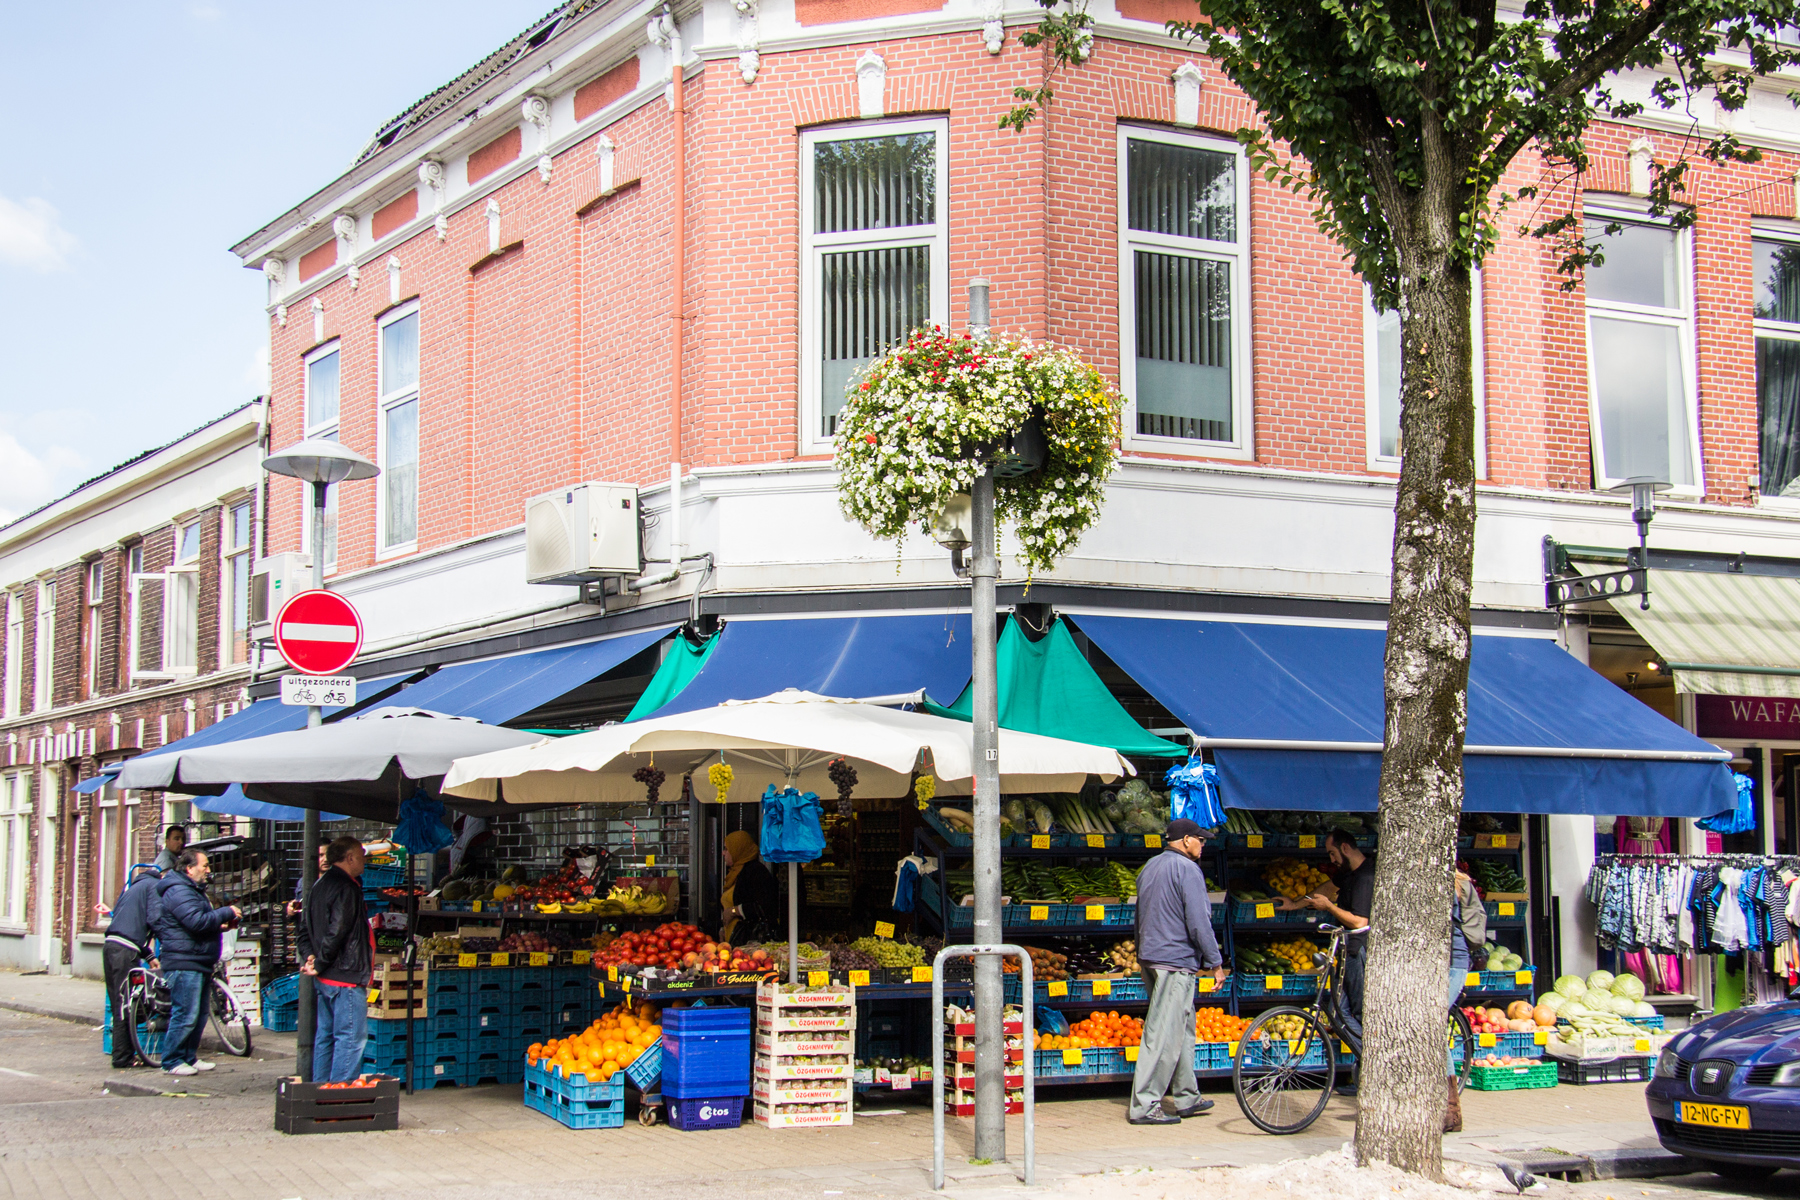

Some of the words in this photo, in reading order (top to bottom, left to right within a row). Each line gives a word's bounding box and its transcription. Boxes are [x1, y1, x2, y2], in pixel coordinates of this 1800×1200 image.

[288, 678, 351, 687] uitgezonderd
[797, 995, 835, 1003] ÖZGENMEYVE
[798, 1019, 836, 1027] ÖZGENMEYVE
[796, 1043, 834, 1051] ÖZGENMEYVE
[796, 1067, 834, 1075] ÖZGENMEYVE
[794, 1091, 832, 1099] ÖZGENMEYVE
[794, 1115, 832, 1123] ÖZGENMEYVE
[1685, 1105, 1741, 1125] 12-NG-FV
